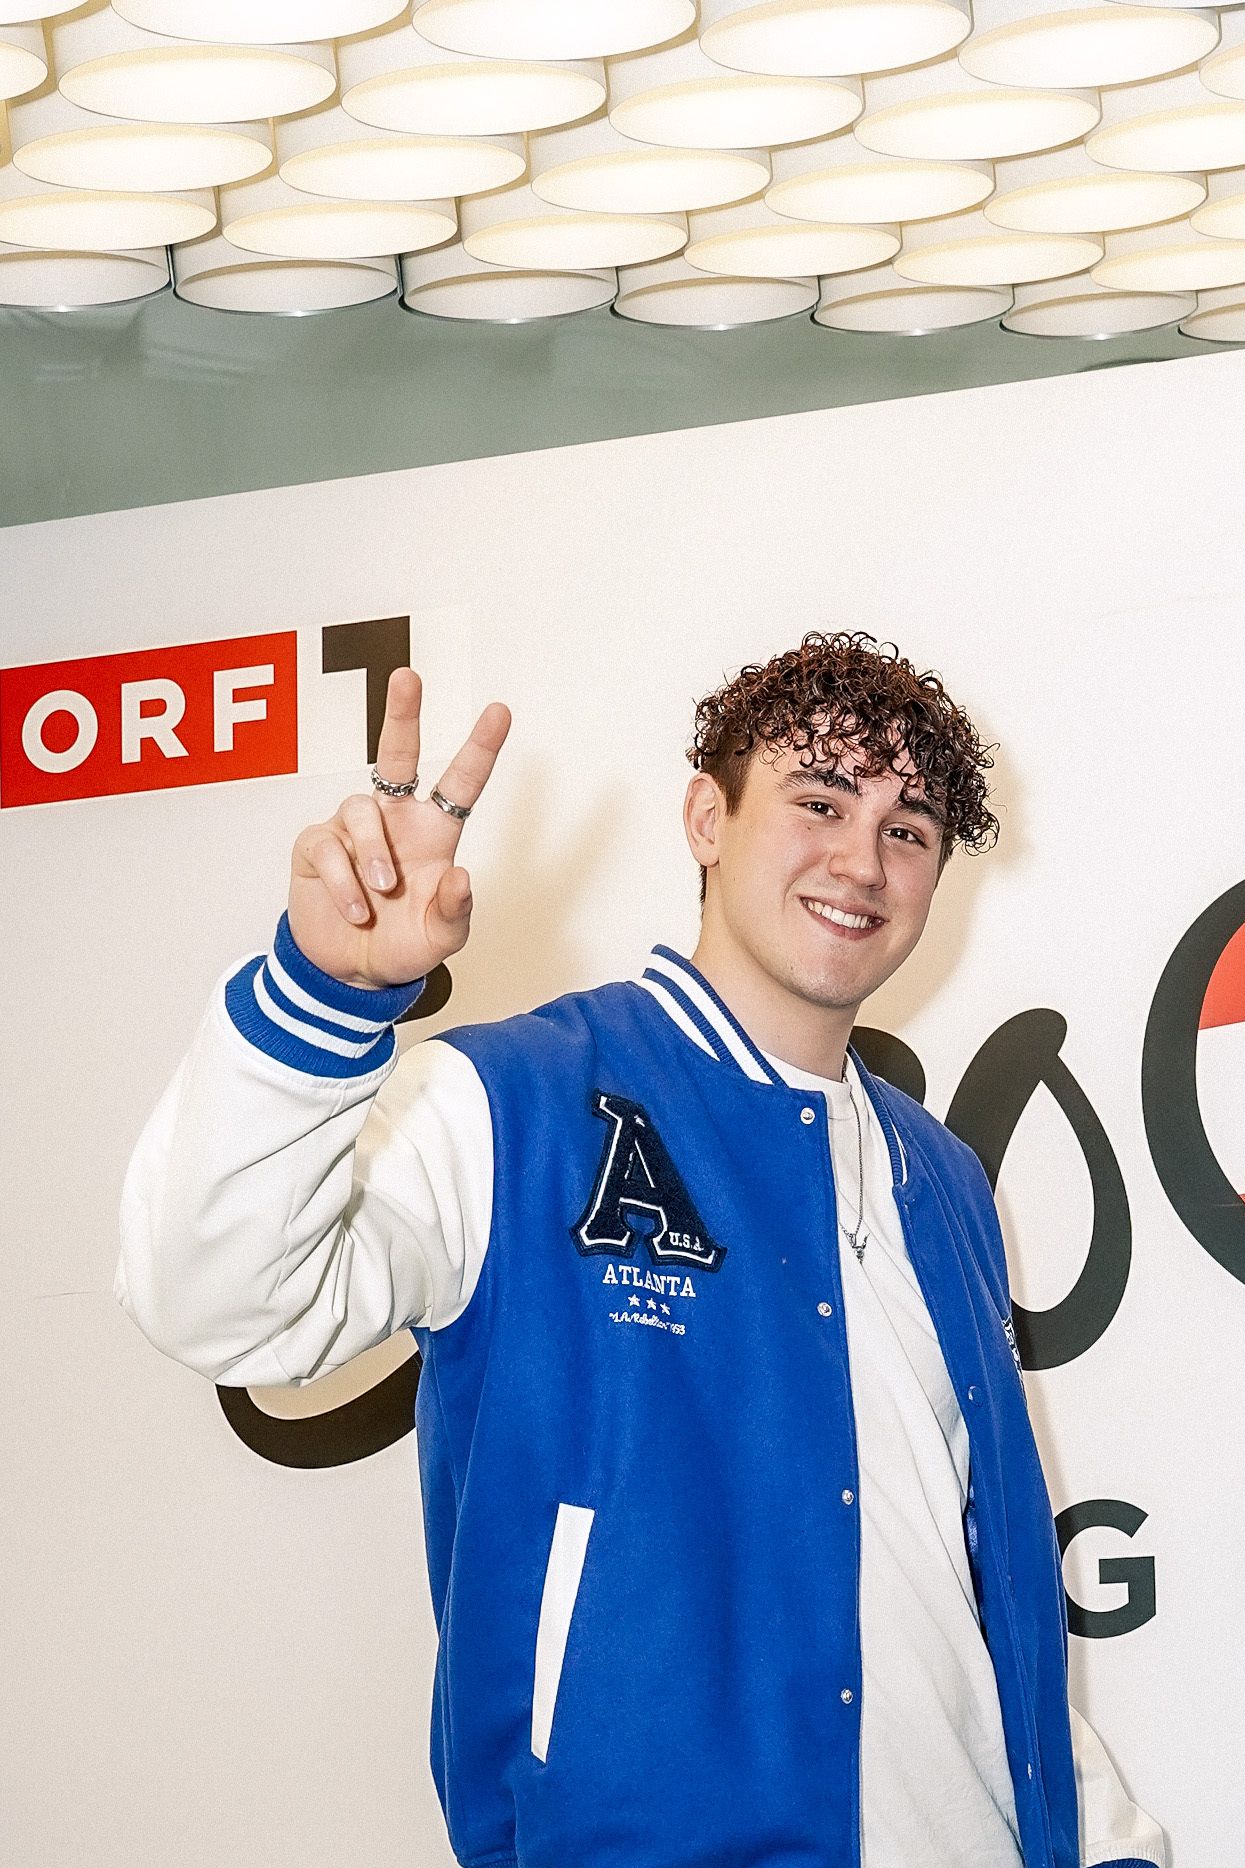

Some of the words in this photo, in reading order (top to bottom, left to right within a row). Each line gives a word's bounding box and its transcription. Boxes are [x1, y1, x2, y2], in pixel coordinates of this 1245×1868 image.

[21, 663, 275, 774] ORF
[568, 1088, 728, 1274] A
[602, 1263, 697, 1298] ATLANTA
